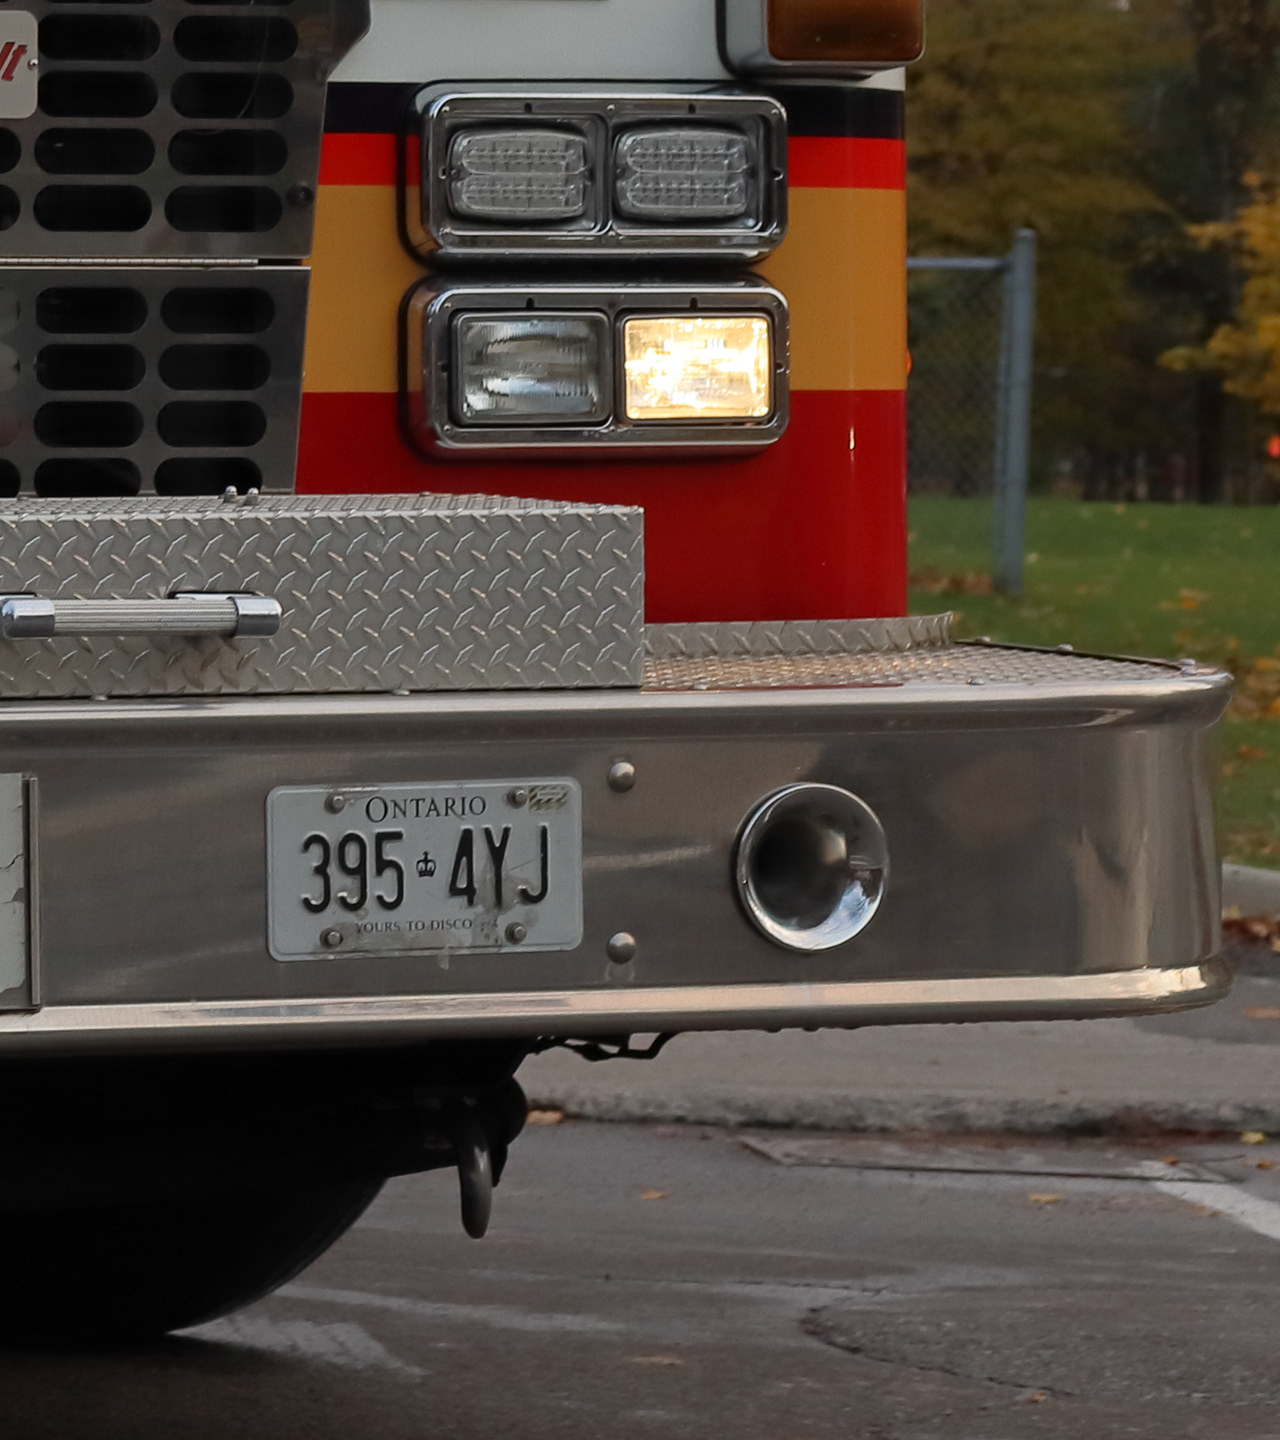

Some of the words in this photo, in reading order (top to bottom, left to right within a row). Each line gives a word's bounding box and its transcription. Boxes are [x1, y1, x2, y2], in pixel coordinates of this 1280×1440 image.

[301, 827, 406, 913] 395
[448, 822, 550, 908] 4YJ
[354, 921, 401, 935] YOURS
[406, 920, 426, 933] TO
